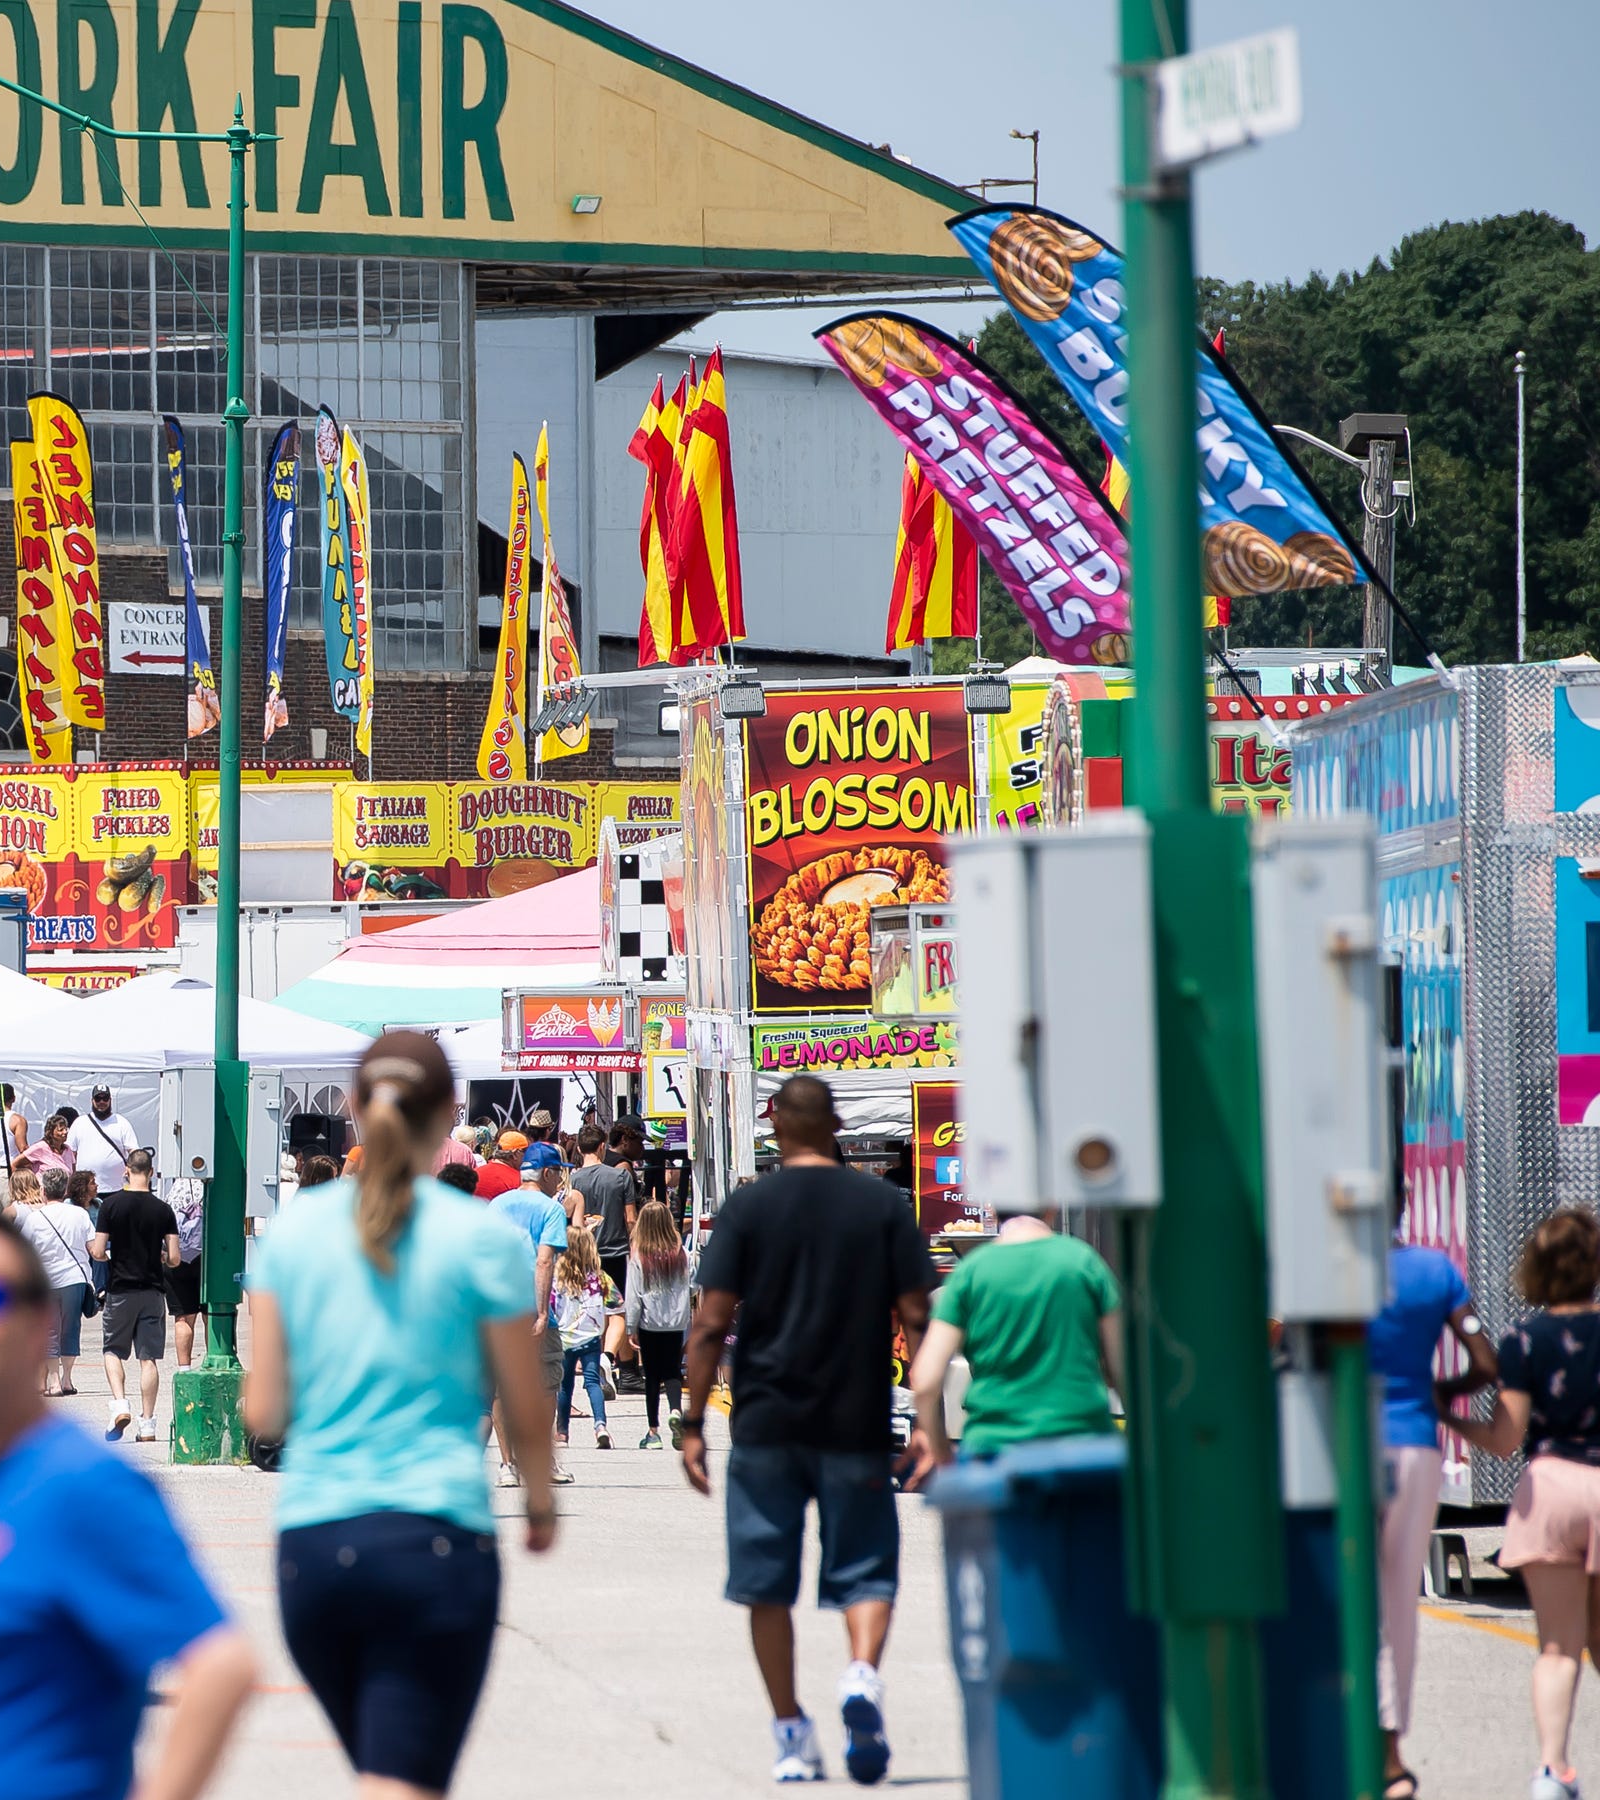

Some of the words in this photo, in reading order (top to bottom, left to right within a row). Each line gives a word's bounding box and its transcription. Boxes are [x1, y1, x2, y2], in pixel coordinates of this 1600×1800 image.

[253, 0, 515, 222] FAIR
[933, 375, 1123, 597] STUFFED
[887, 379, 1098, 640] PRETZELS
[124, 608, 186, 625] CONCER
[120, 629, 186, 646] ENTRAN
[102, 787, 160, 814] FRIED
[356, 795, 427, 822] ITALIAN
[459, 786, 587, 833] DOUGHNUT
[627, 796, 673, 820] PHILLY
[749, 773, 973, 848] BLOSSOM
[91, 813, 172, 839] PICKLES
[355, 821, 430, 851] SAUSAGE
[474, 825, 575, 867] BURGER
[761, 1030, 807, 1045] Freshly
[810, 1022, 868, 1039] Squeezed
[539, 1055, 568, 1067] DRINKS
[575, 1056, 596, 1067] SOFT
[597, 1056, 622, 1068] SERVE
[622, 1056, 636, 1068] ICE
[762, 1026, 940, 1070] LEMONADE
[943, 1191, 963, 1201] For
